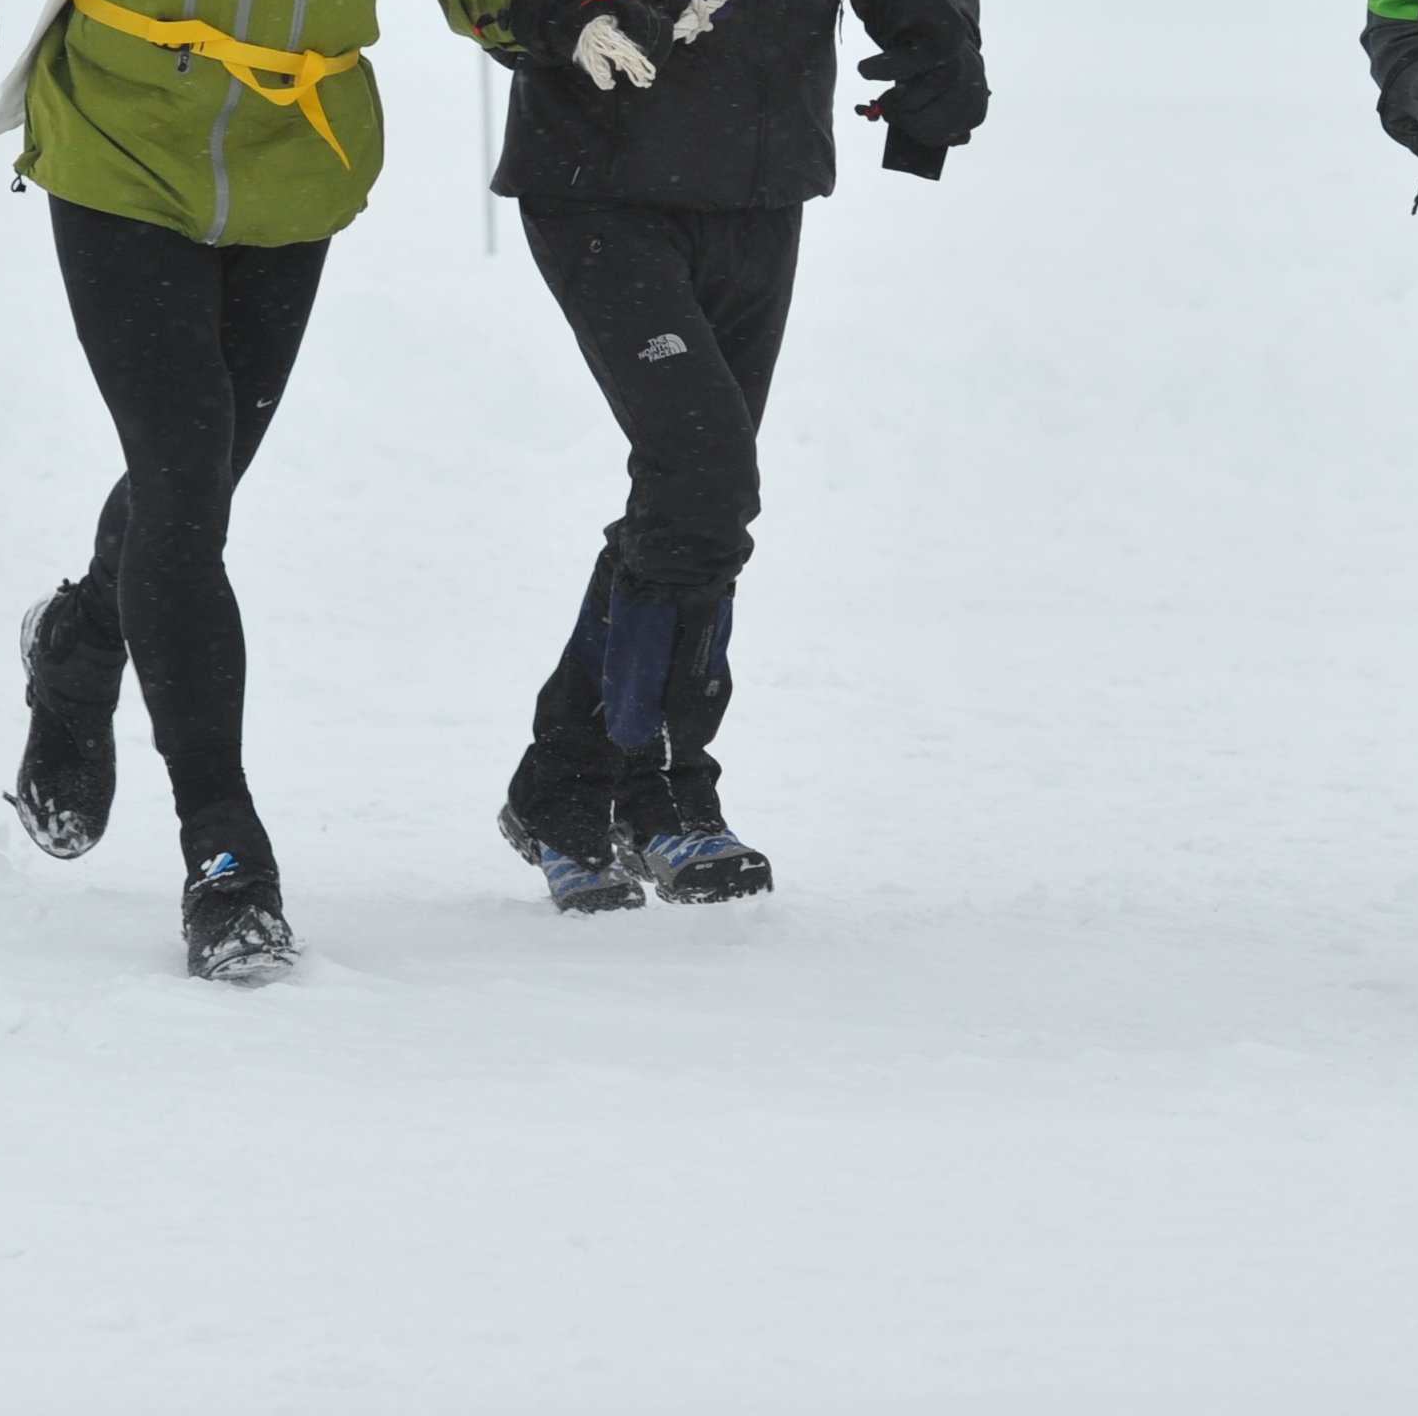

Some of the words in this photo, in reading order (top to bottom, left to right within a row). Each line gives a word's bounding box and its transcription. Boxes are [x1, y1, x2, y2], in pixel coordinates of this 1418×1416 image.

[647, 334, 667, 347] THE
[638, 343, 670, 360] NORTH
[648, 349, 672, 363] FACE
